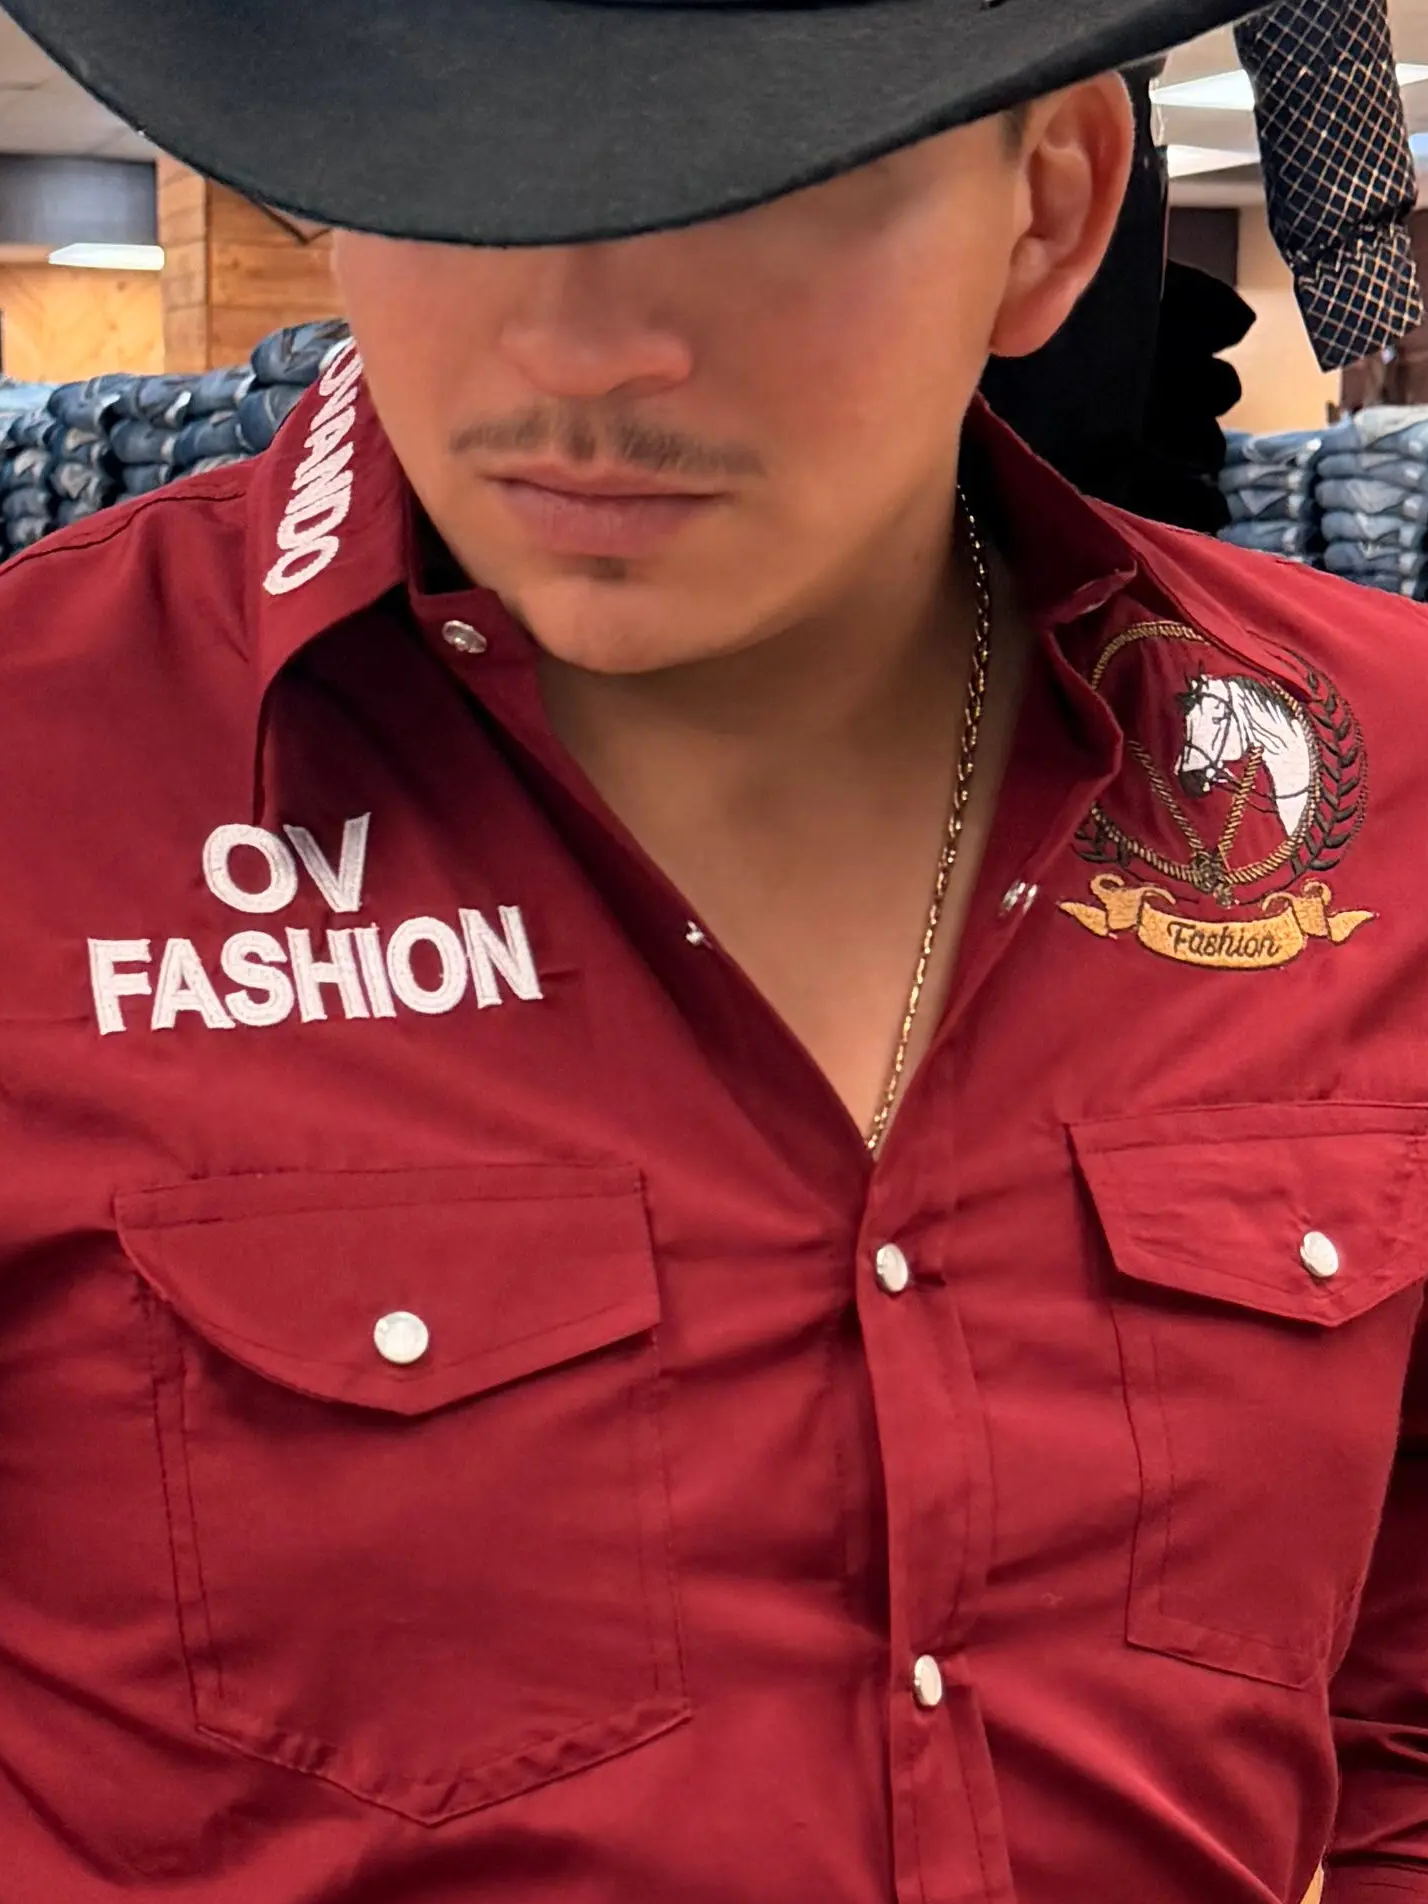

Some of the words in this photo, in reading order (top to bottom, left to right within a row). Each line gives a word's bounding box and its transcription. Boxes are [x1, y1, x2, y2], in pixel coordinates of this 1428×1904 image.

[202, 811, 371, 914] OV
[87, 905, 544, 1036] FASHION
[1166, 921, 1282, 957] Fashion
